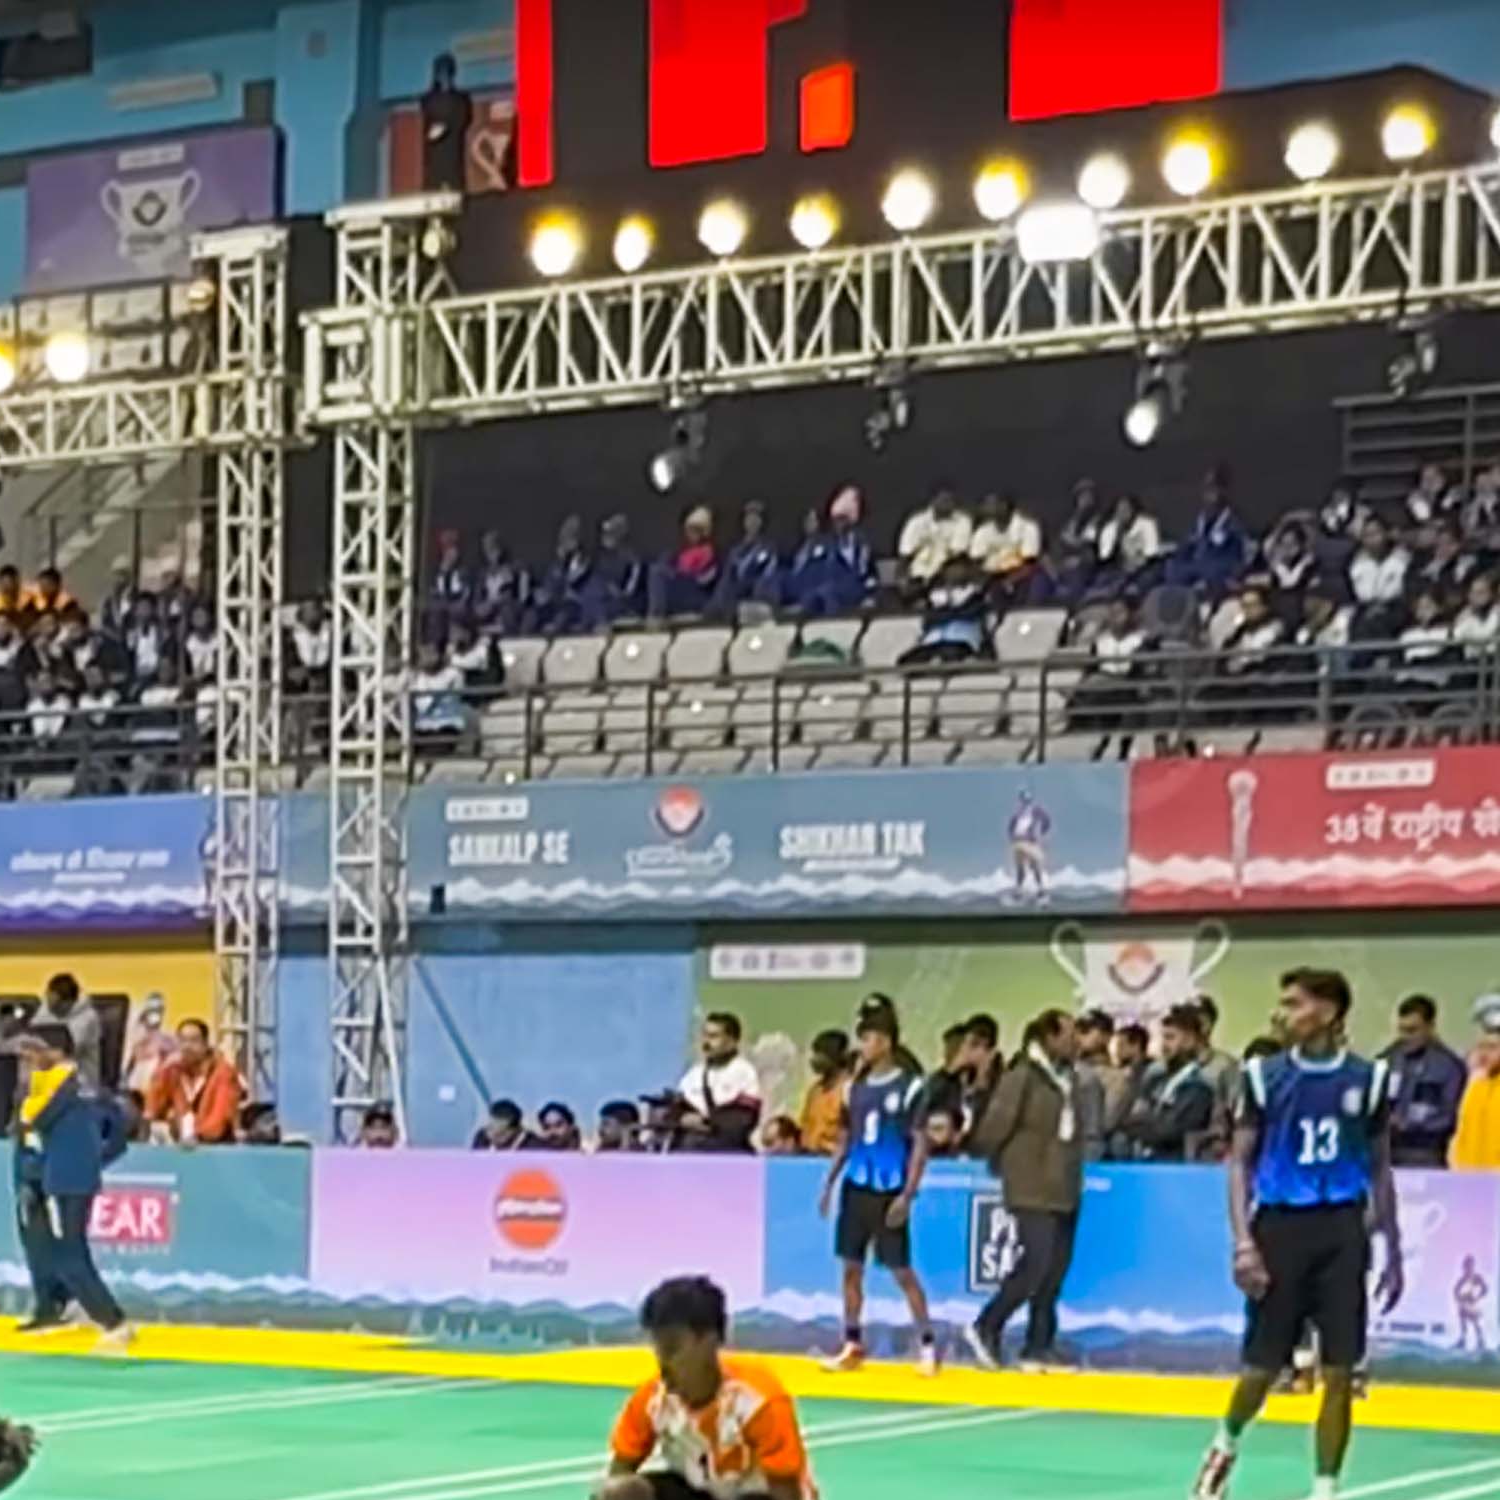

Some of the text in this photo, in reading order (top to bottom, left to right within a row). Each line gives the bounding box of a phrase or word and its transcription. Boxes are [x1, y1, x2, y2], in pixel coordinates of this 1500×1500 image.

[1471, 797, 1500, 837] खे
[542, 831, 569, 864] SE
[1298, 1116, 1339, 1164] 13
[86, 1195, 162, 1237] EAR
